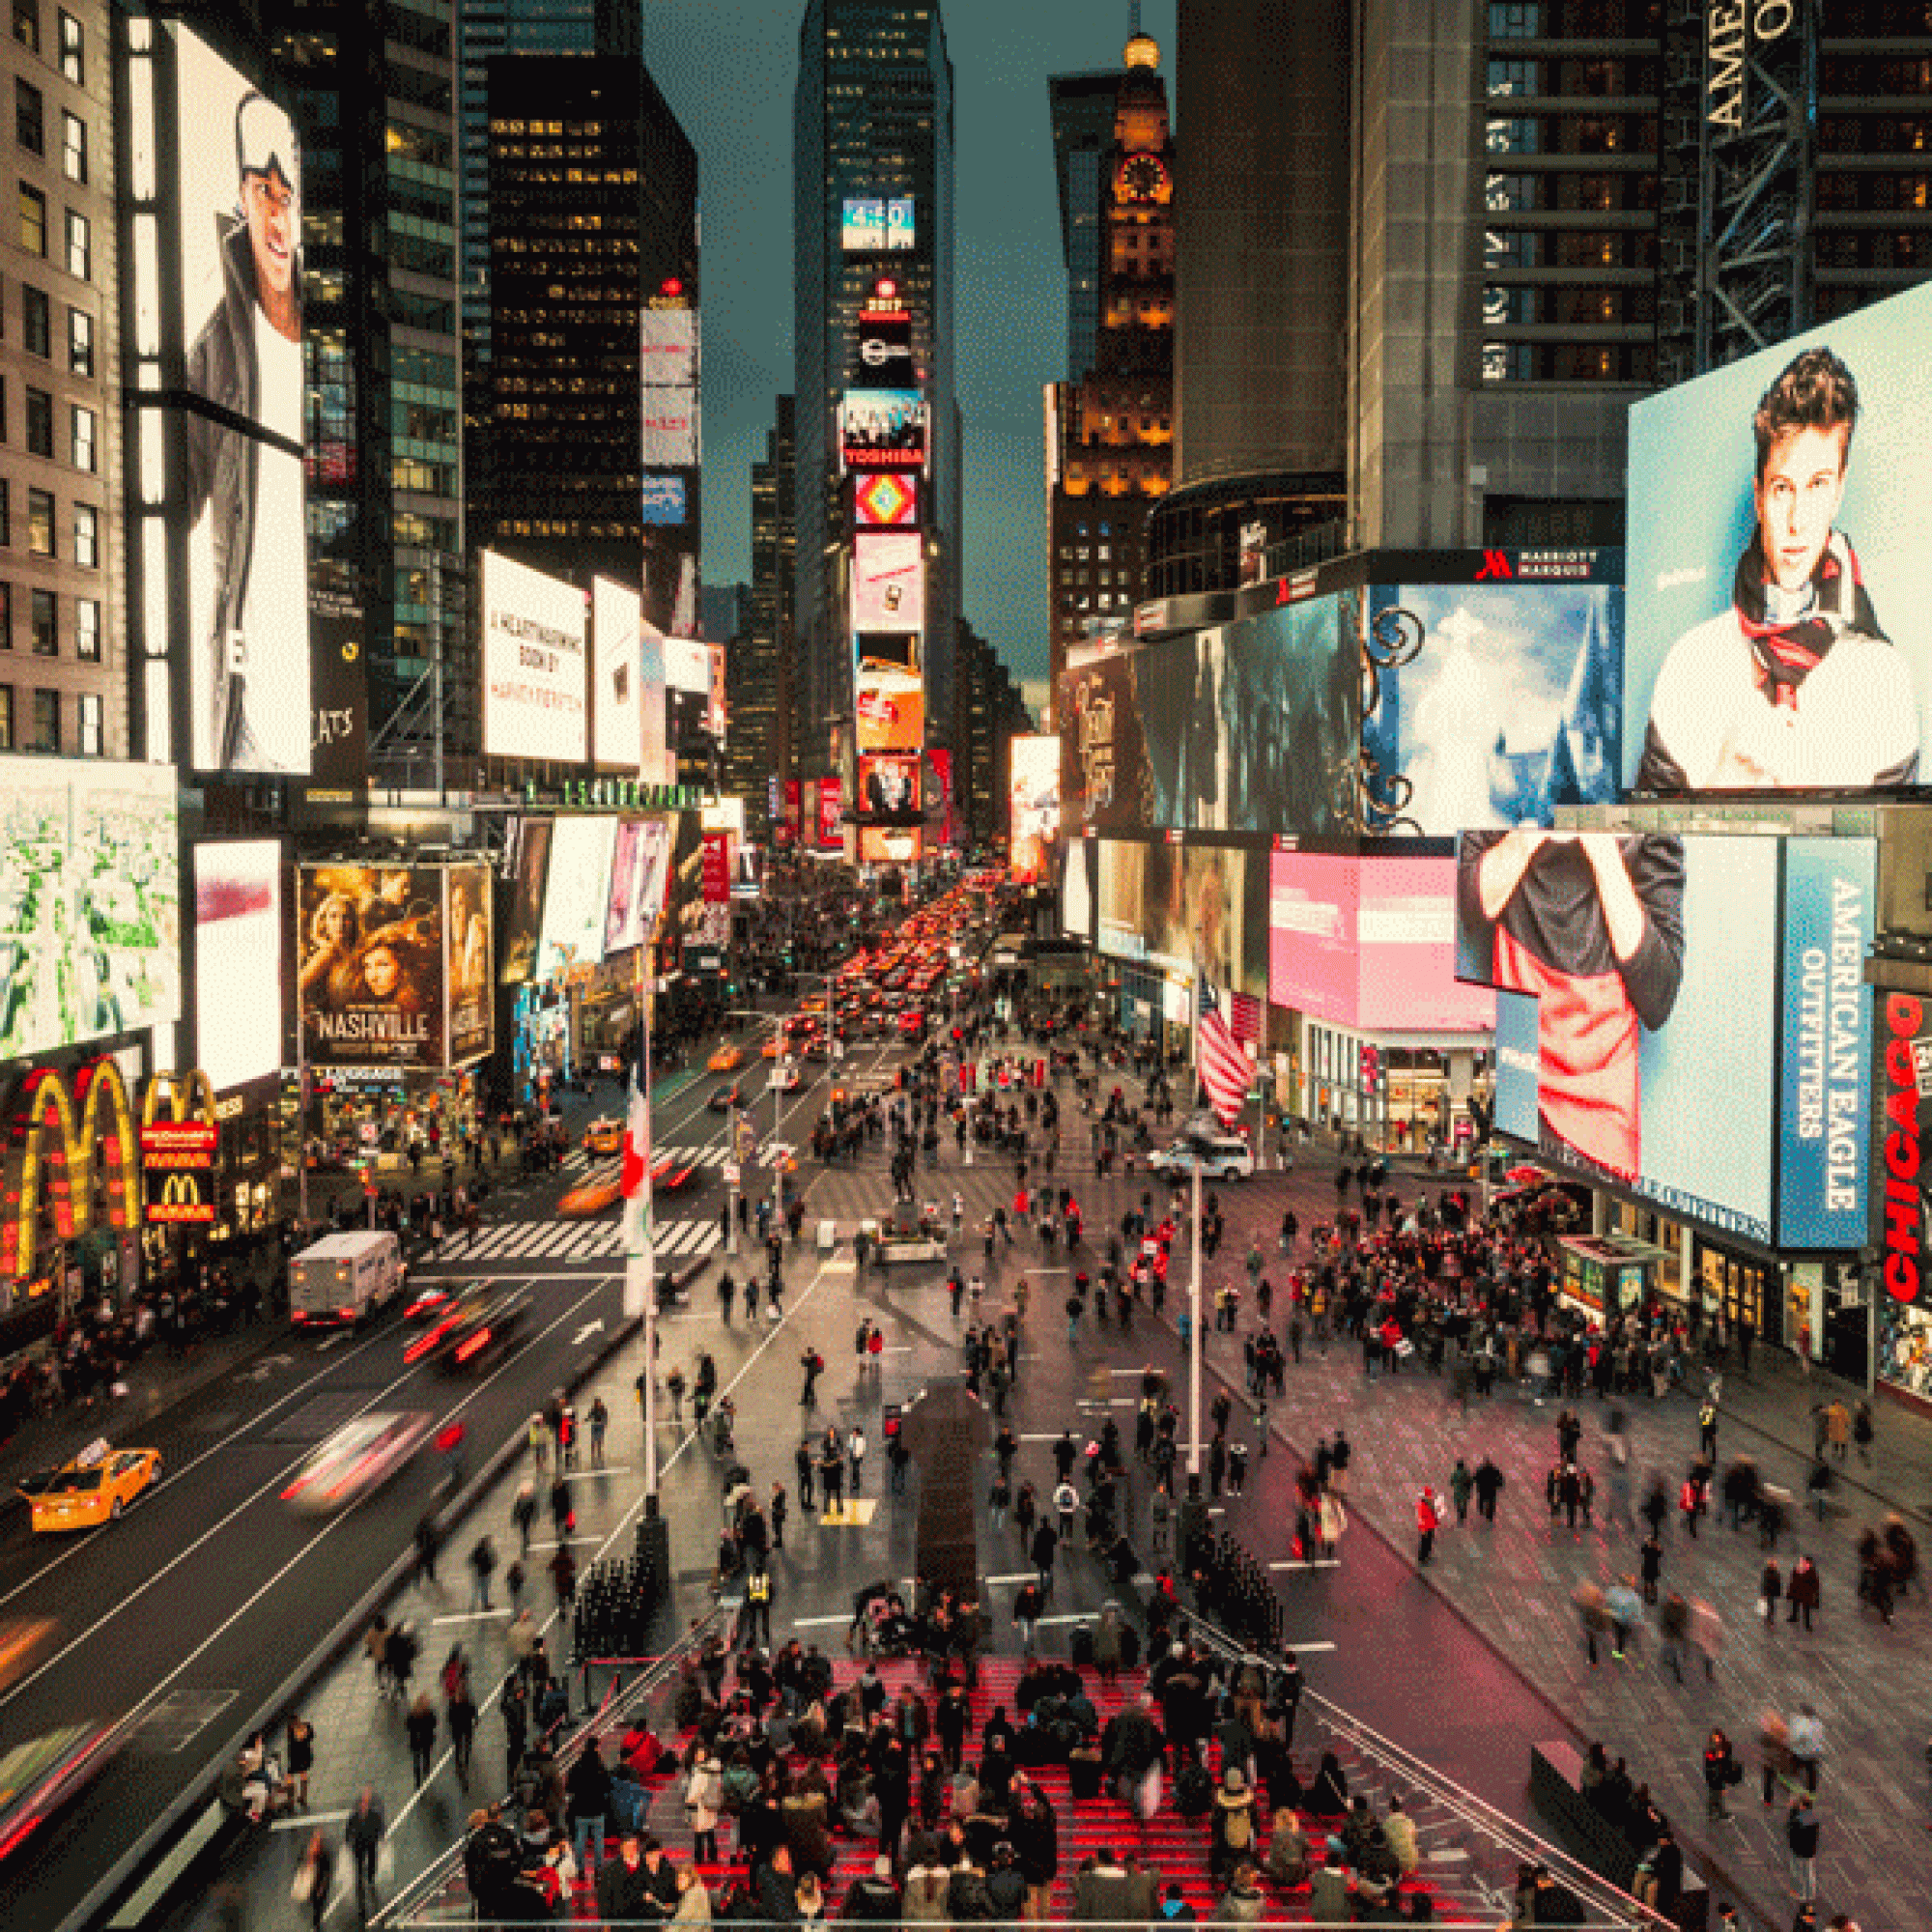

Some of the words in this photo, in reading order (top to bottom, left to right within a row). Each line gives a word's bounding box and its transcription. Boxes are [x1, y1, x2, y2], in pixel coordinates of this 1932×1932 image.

[1706, 0, 1747, 129] AME
[845, 448, 924, 465] TOSHIBA
[1520, 551, 1598, 563] MARRIOTT
[309, 706, 354, 752] ATS
[318, 1013, 430, 1042] NASHVILLE
[1828, 878, 1863, 1080] AMERICAN
[1798, 949, 1827, 1139] OUTFITTERS
[1825, 1091, 1860, 1210] EAGLE
[1885, 994, 1922, 1302] CHICAGO
